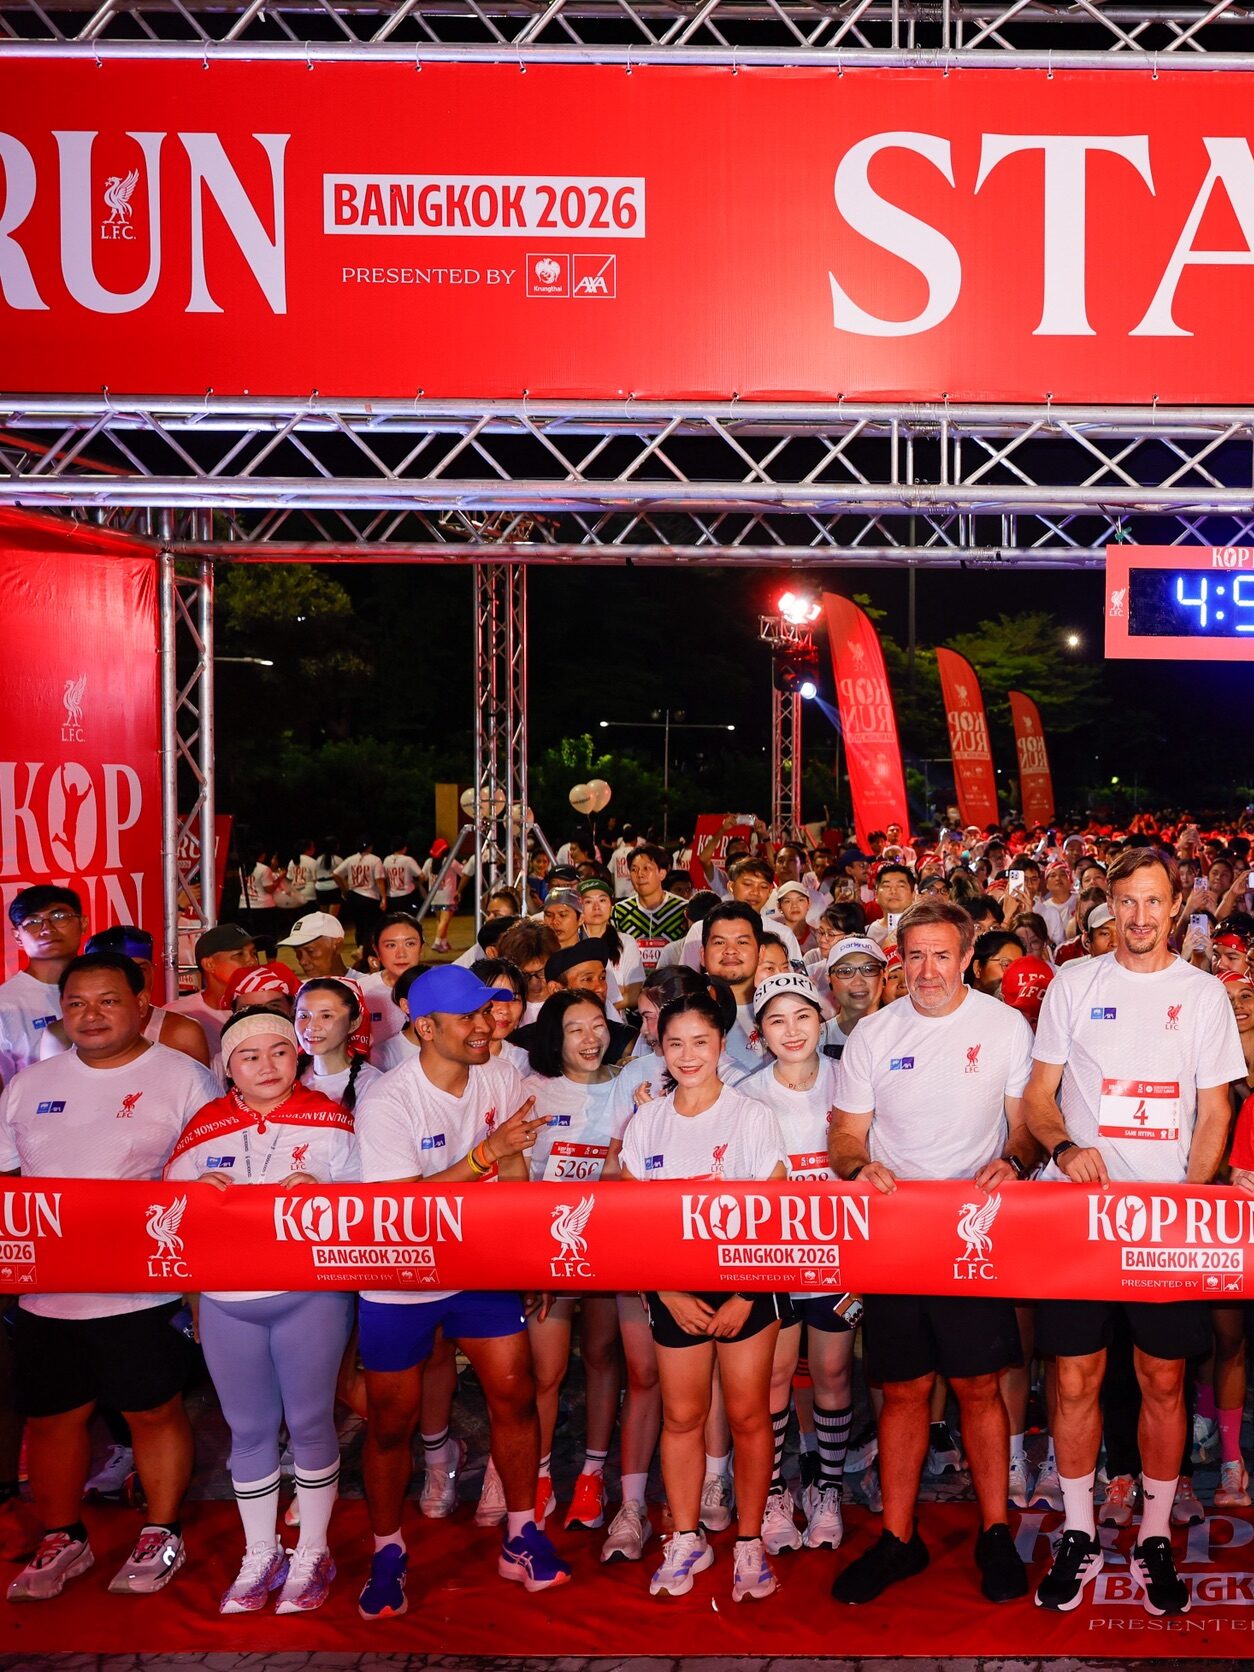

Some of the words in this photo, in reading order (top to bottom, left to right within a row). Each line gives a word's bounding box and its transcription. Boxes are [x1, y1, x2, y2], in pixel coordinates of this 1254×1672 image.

[334, 183, 527, 229] BANGKOK
[534, 186, 638, 229] 2026
[101, 225, 137, 240] L.F.C.
[342, 267, 481, 285] PRESENTED
[486, 269, 516, 285] BY
[574, 275, 608, 294] AXA
[533, 285, 563, 293] Krungthai
[1211, 547, 1249, 568] KOP
[0, 761, 143, 876] KOP
[1132, 1099, 1149, 1126] 4
[0, 1192, 63, 1238] UN
[273, 1196, 365, 1242] KOP
[373, 1196, 465, 1243] RUN
[681, 1194, 772, 1241] KOP
[780, 1195, 870, 1242] RUN
[1087, 1194, 1178, 1243] KOP
[316, 1248, 390, 1265] BANGKOK
[391, 1248, 432, 1264] 2026
[721, 1248, 795, 1264] BANGKOK
[797, 1248, 837, 1264] 2026
[1125, 1251, 1198, 1269] BANGKOK
[1200, 1251, 1240, 1269] 2026
[148, 1261, 193, 1279] L.F.C.
[550, 1262, 596, 1278] L.F.C.
[719, 1273, 781, 1281] PRESENTED
[782, 1274, 796, 1282] BY
[953, 1264, 998, 1280] L.F.C.
[1121, 1279, 1184, 1288] PRESENTED
[1185, 1280, 1199, 1289] BY
